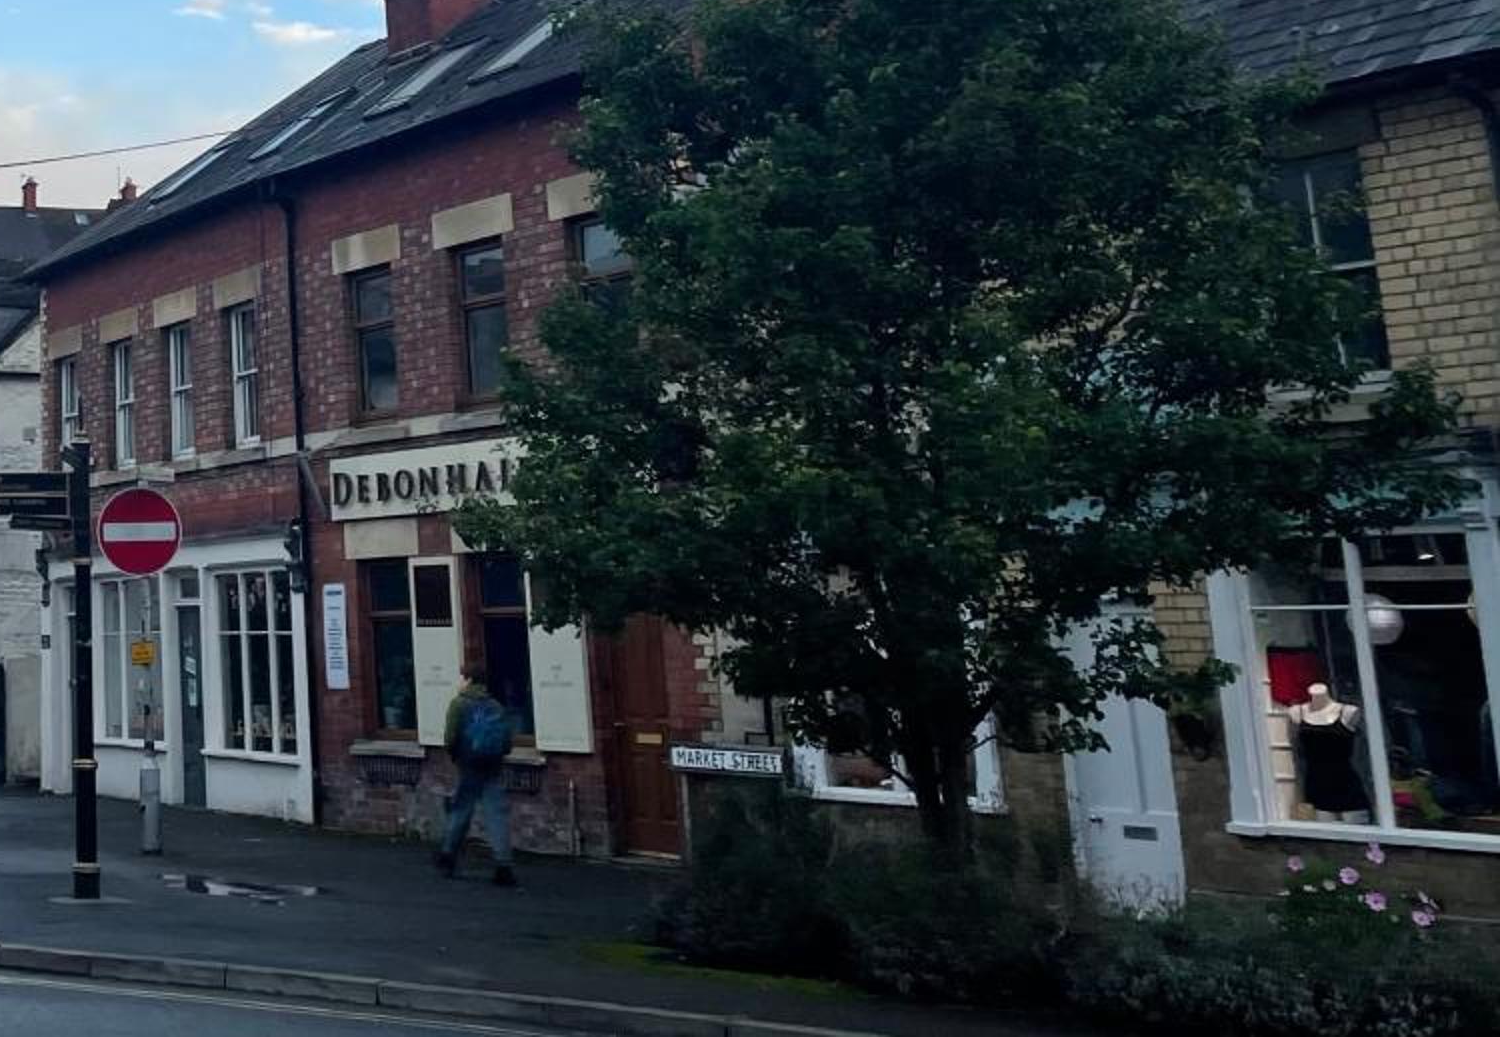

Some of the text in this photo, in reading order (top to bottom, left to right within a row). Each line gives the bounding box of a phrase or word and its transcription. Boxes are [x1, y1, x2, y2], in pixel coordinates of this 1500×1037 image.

[333, 457, 523, 507] DEBONHAI
[676, 749, 778, 772] MARKET STREET
